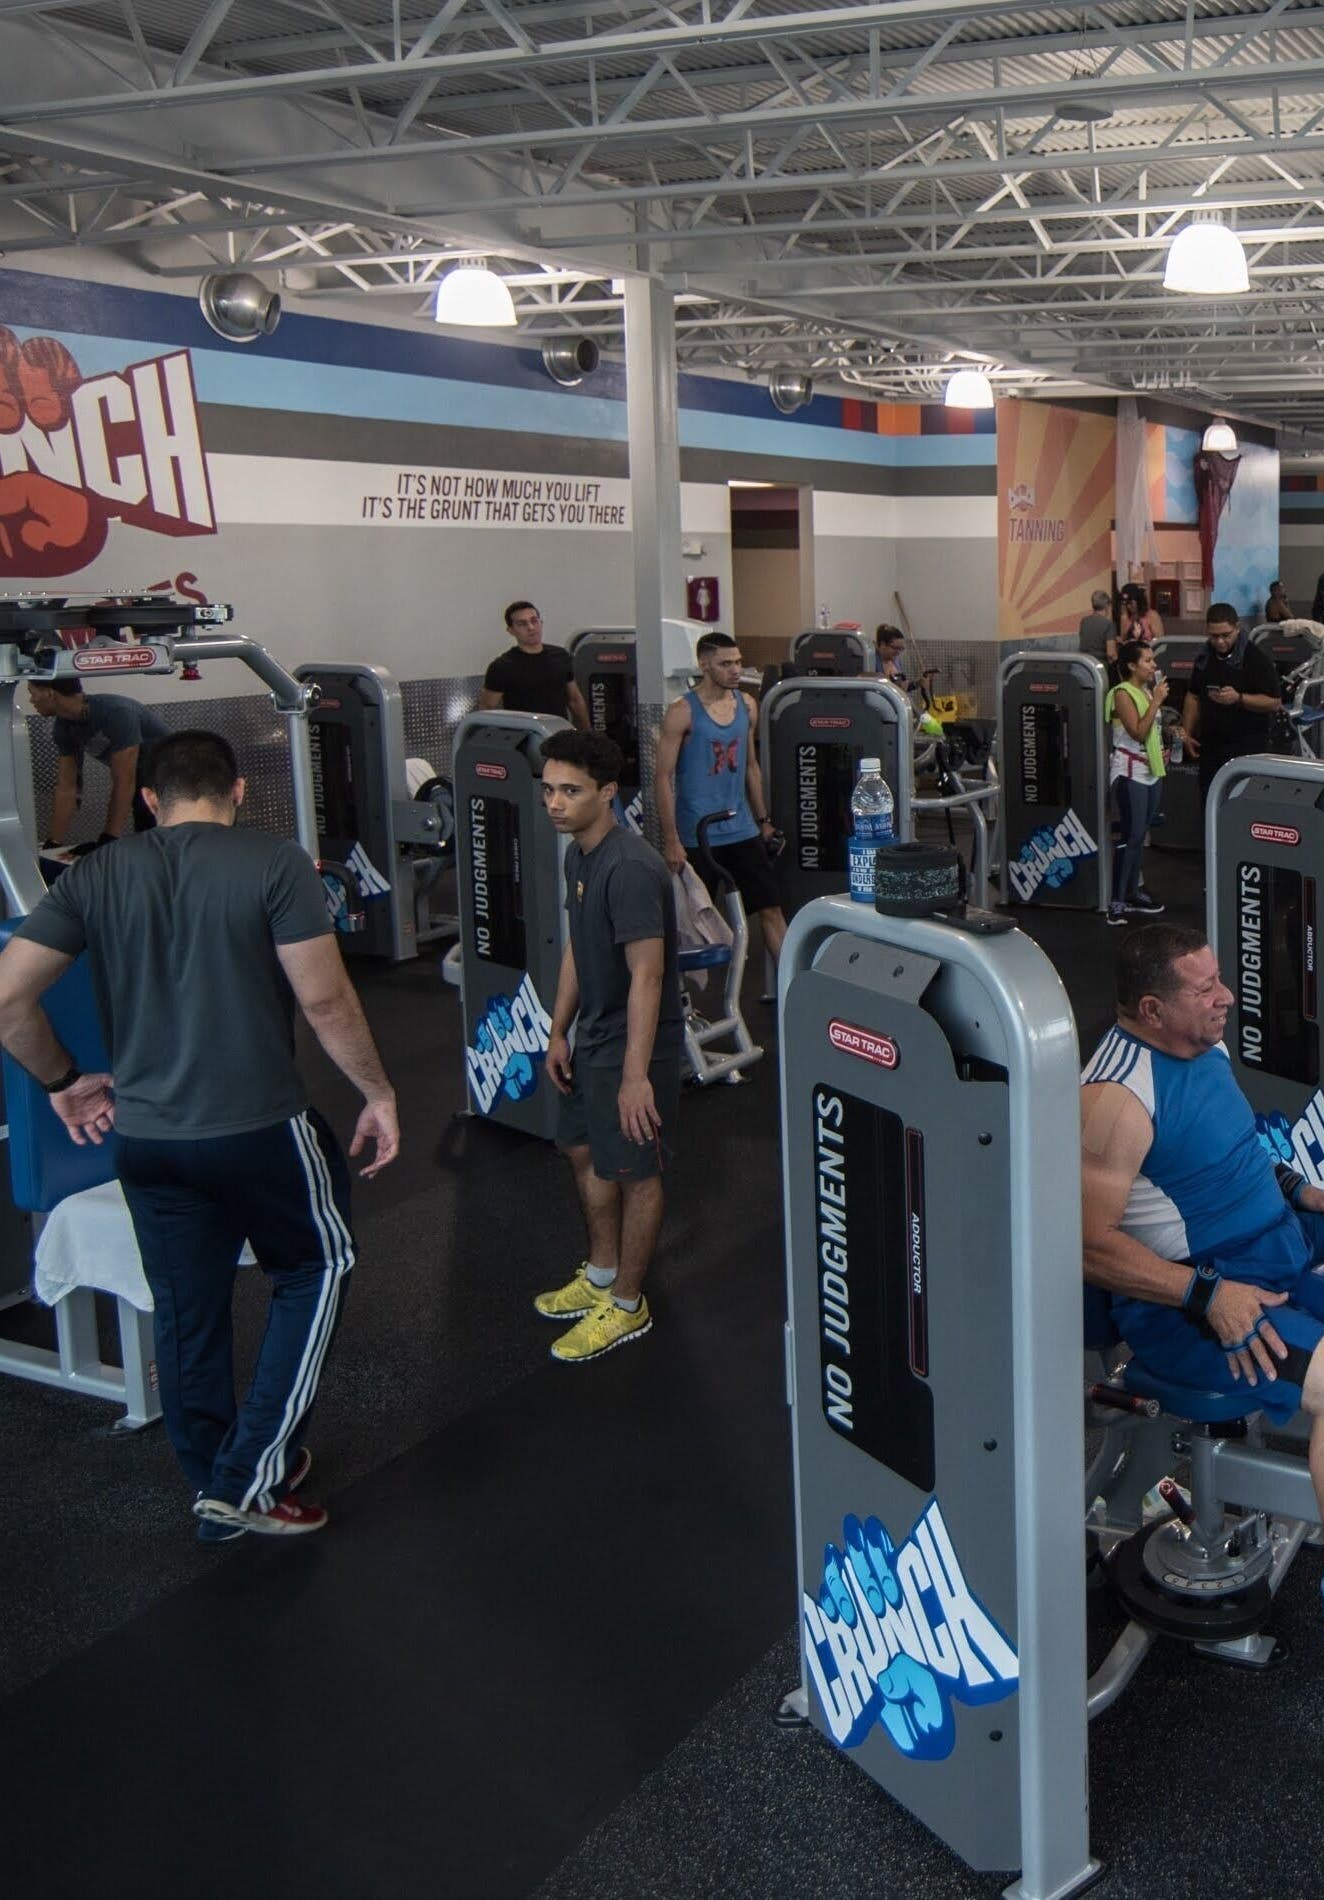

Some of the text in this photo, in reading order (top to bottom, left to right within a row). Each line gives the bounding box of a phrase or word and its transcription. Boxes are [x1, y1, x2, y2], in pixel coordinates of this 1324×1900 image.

[0, 352, 215, 529] NCH
[361, 496, 625, 525] IT'S THE GRUNT THAT GETS YOU THERE
[397, 473, 601, 503] IT'S NOT HOW MUCH YOU LIFT
[1009, 518, 1065, 542] TANNING
[77, 653, 151, 666] STAR TRAC
[591, 681, 607, 732] GMENTS
[1022, 705, 1039, 803] NO JUDGMENTS
[799, 744, 819, 868] NO JUDGMENTS
[1252, 826, 1296, 841] STAR TRAC
[470, 795, 491, 957] NO JUDGMENTS
[853, 856, 878, 868] EXPL
[1008, 807, 1099, 901] CRUNCH
[1240, 865, 1263, 1063] NO JUDGMENTS
[1306, 924, 1314, 973] ADDUCTOR
[468, 971, 553, 1114] CRUNCH
[832, 1029, 891, 1059] STAR TRAC
[817, 1092, 855, 1431] NO JUDGMENTS
[910, 1212, 922, 1295] ADDUCTOR
[803, 1499, 1020, 1745] CRUNCH
